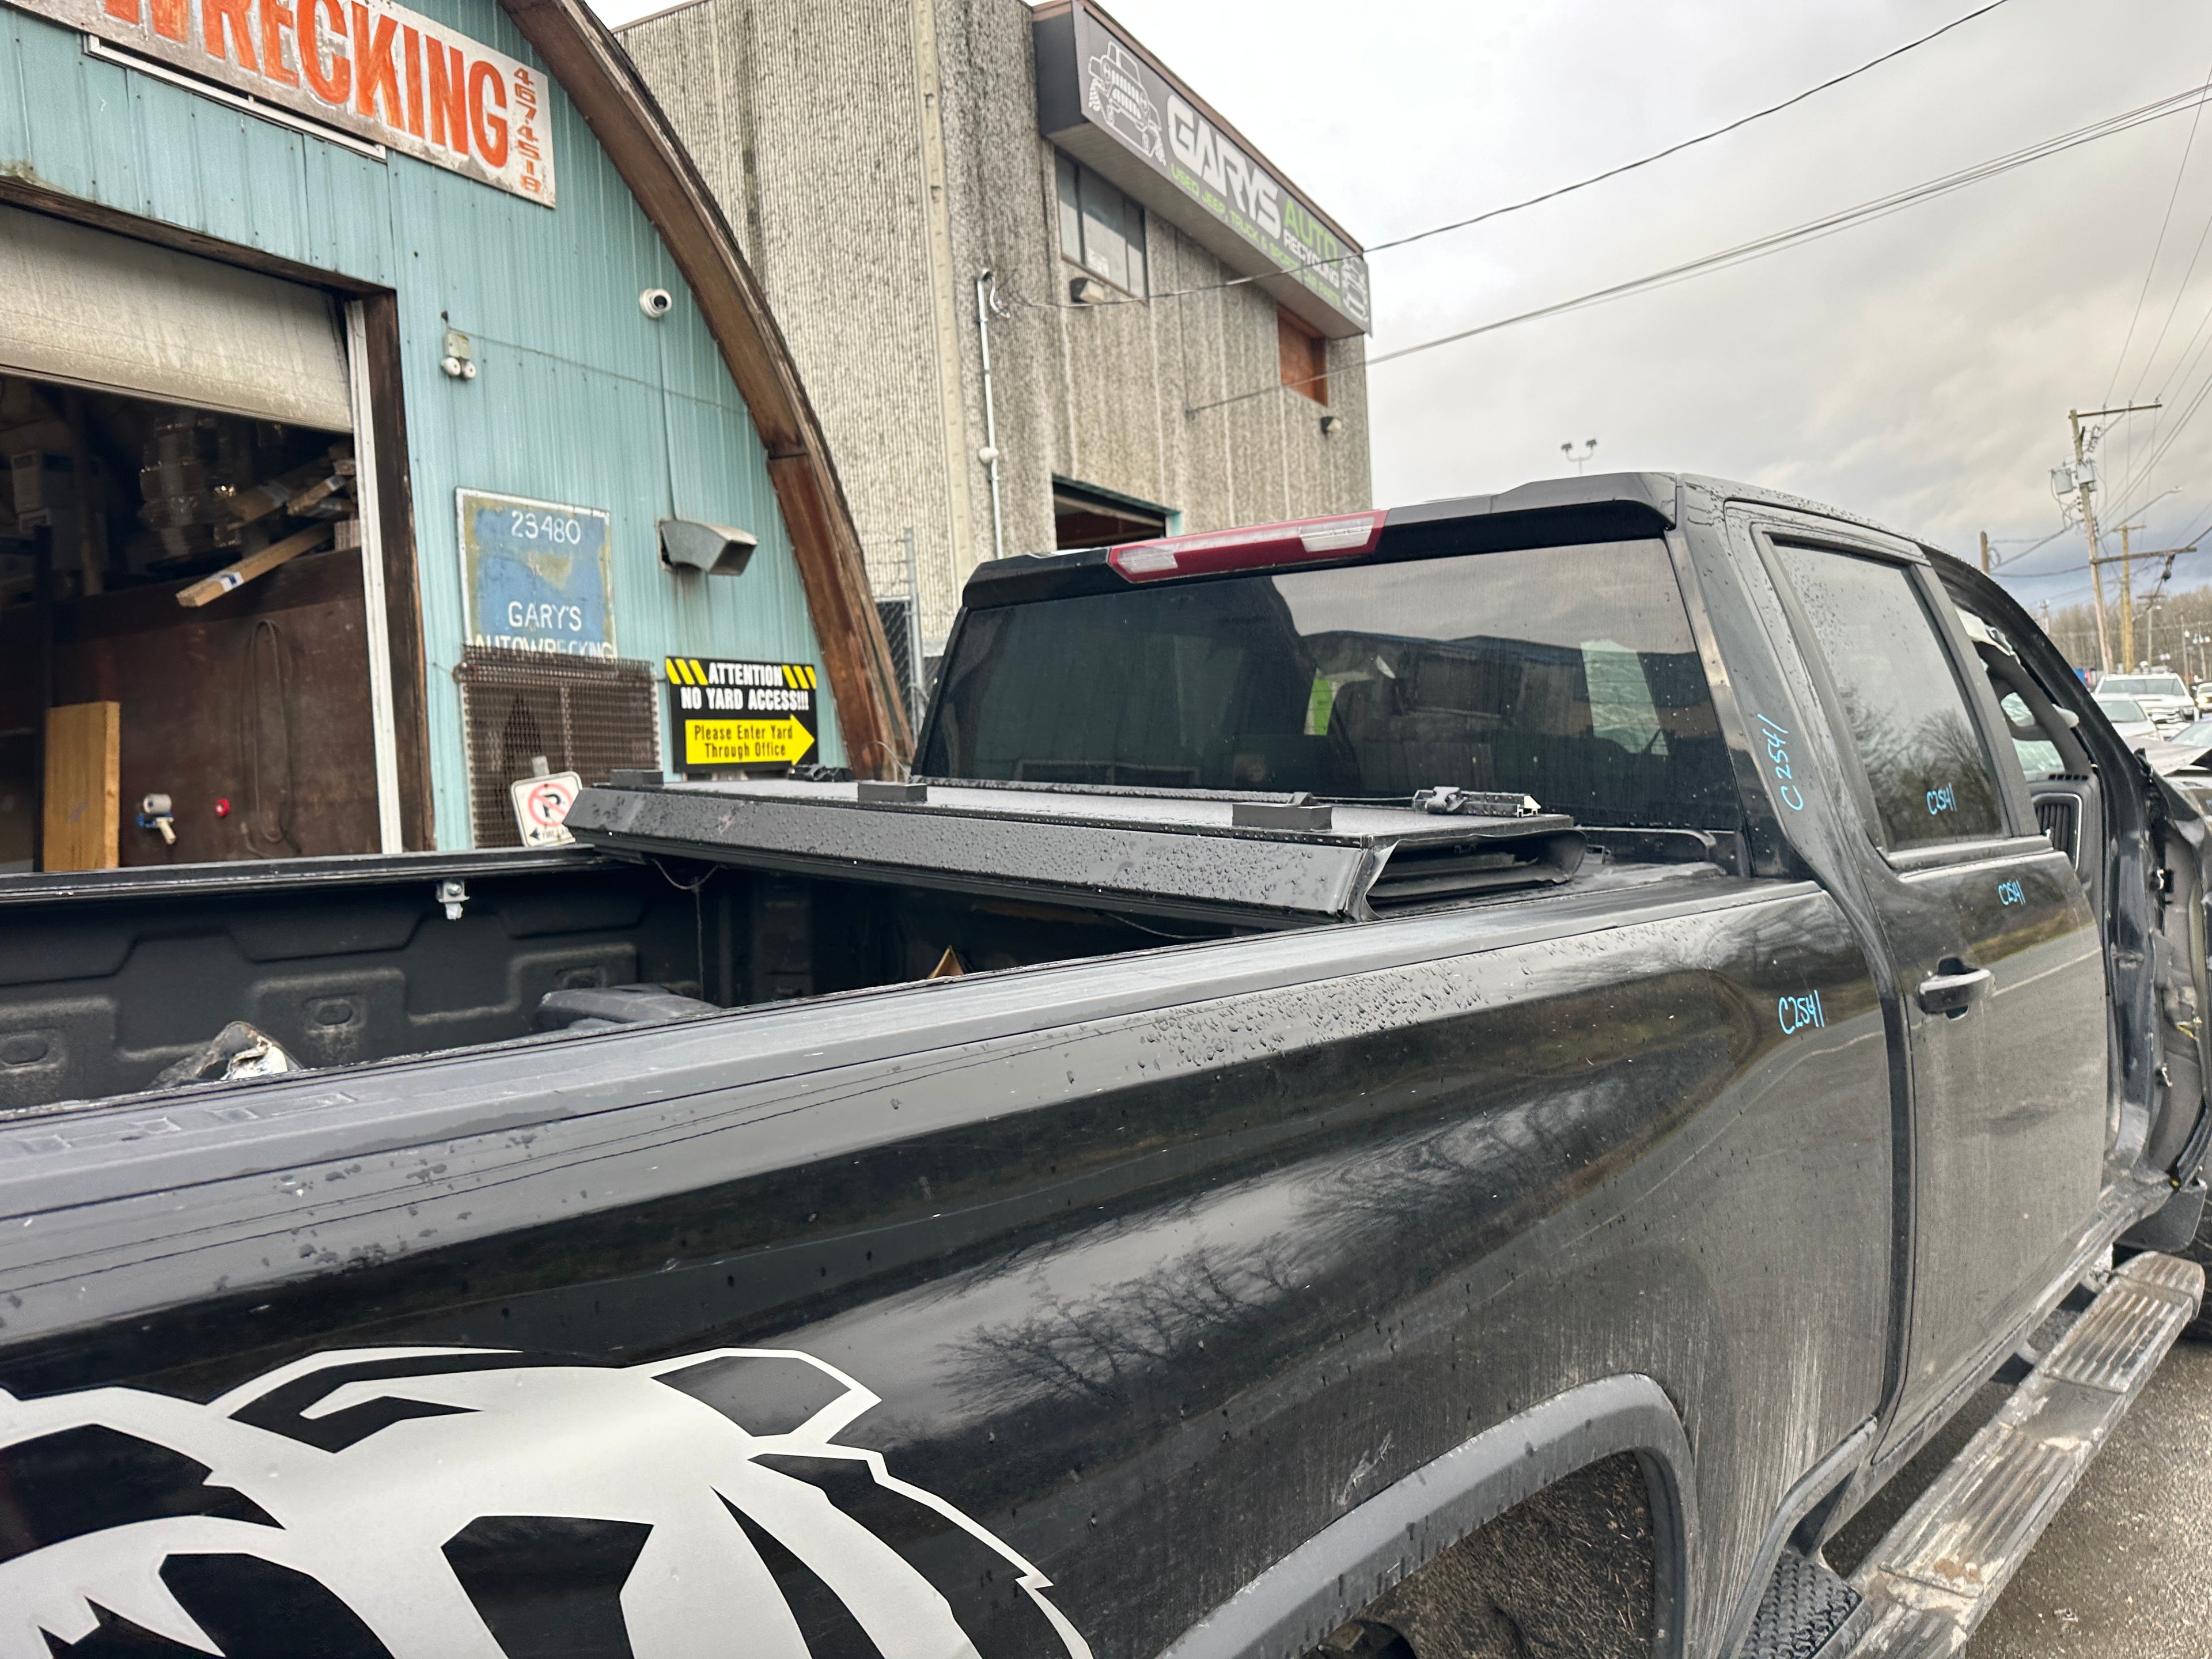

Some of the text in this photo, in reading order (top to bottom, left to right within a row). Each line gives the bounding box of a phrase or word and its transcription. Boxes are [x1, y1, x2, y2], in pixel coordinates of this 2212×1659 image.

[1167, 94, 1281, 240] GARYS
[1171, 162, 1199, 197] USED
[1229, 209, 1258, 242] TRUCK
[1283, 199, 1338, 269] AUTO
[1283, 229, 1340, 289] RECYCLING
[511, 510, 581, 545] 23480
[508, 601, 582, 631] GARY'S
[708, 662, 783, 687] ATTENTION
[680, 687, 809, 711] NO YARD ACCESS!!!
[694, 724, 793, 740] Please Enter Yard
[704, 742, 786, 760] Through Office
[1926, 783, 1957, 815] C2541
[1998, 880, 2024, 906] C2541
[1778, 990, 1824, 1035] C2541
